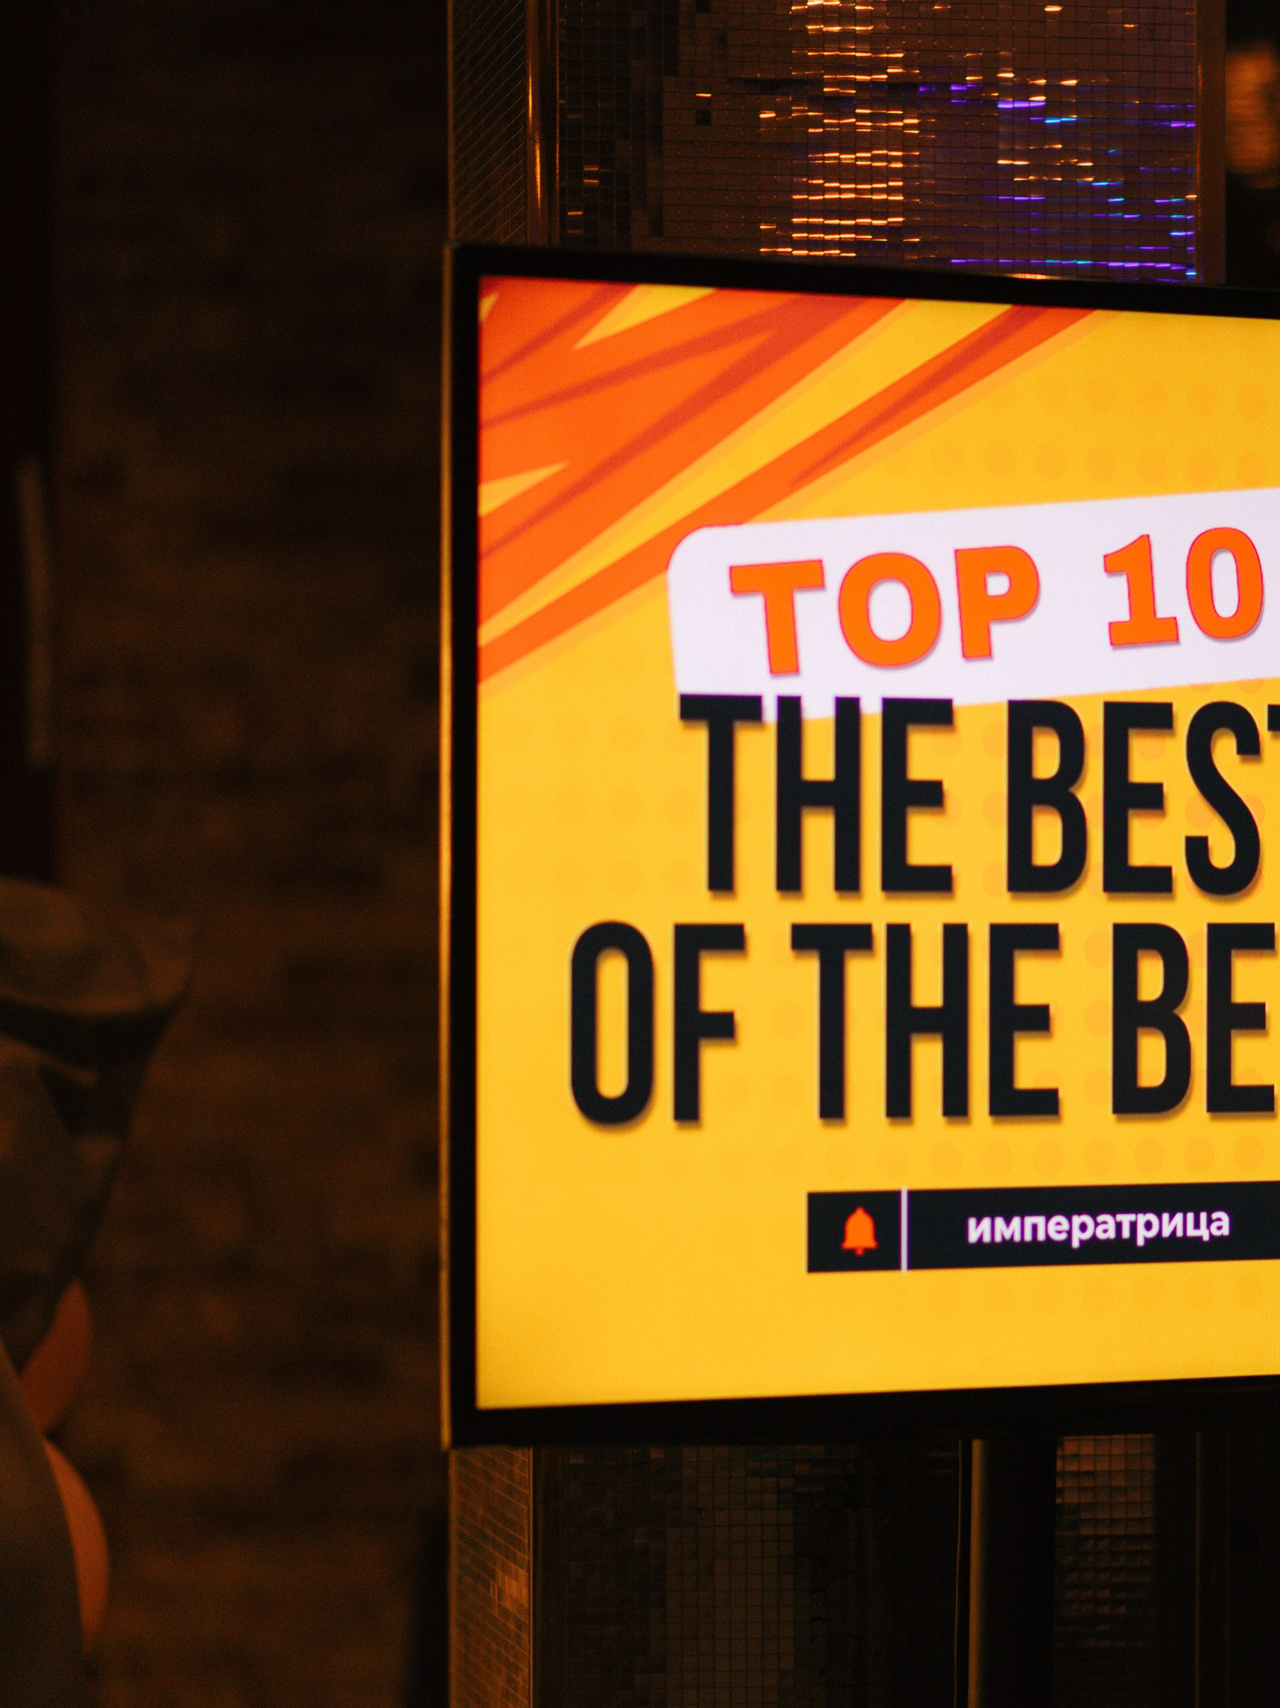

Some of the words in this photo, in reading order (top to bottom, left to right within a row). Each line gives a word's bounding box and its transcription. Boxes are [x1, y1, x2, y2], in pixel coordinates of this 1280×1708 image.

[728, 544, 1041, 677] TOP
[1102, 526, 1265, 648] 10
[678, 693, 954, 894] THE
[569, 920, 747, 1126] OF
[790, 922, 1062, 1120] THE
[966, 1210, 1231, 1249] императрица
